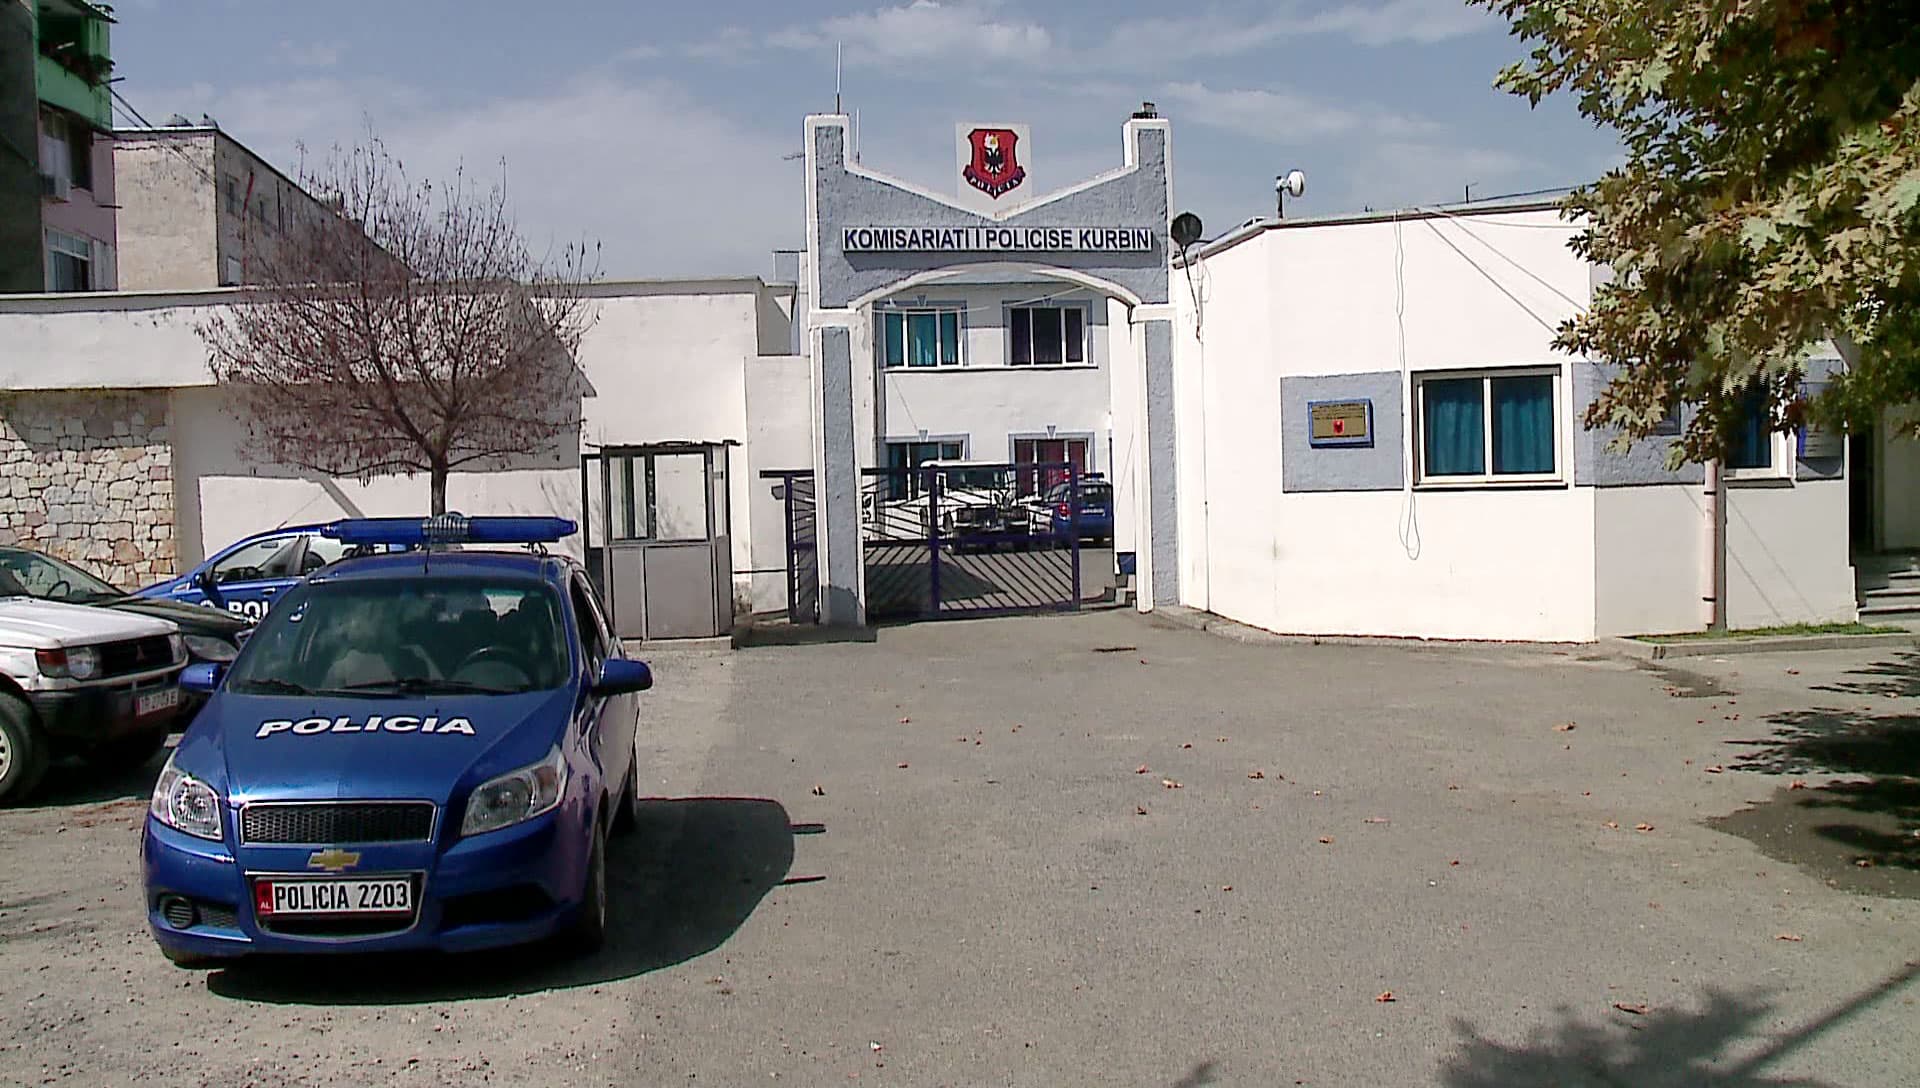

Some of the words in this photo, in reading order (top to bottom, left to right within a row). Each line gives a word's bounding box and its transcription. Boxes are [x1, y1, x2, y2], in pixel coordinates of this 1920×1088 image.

[969, 177, 1019, 197] POLICIA
[844, 229, 969, 249] KOMISARIATI
[975, 229, 980, 249] I
[986, 229, 1073, 248] POLICISE
[1079, 229, 1149, 249] KURBIN
[255, 716, 476, 739] POLICIA
[260, 902, 271, 910] AL
[274, 885, 350, 911] POLICIA
[357, 883, 408, 909] 2203
